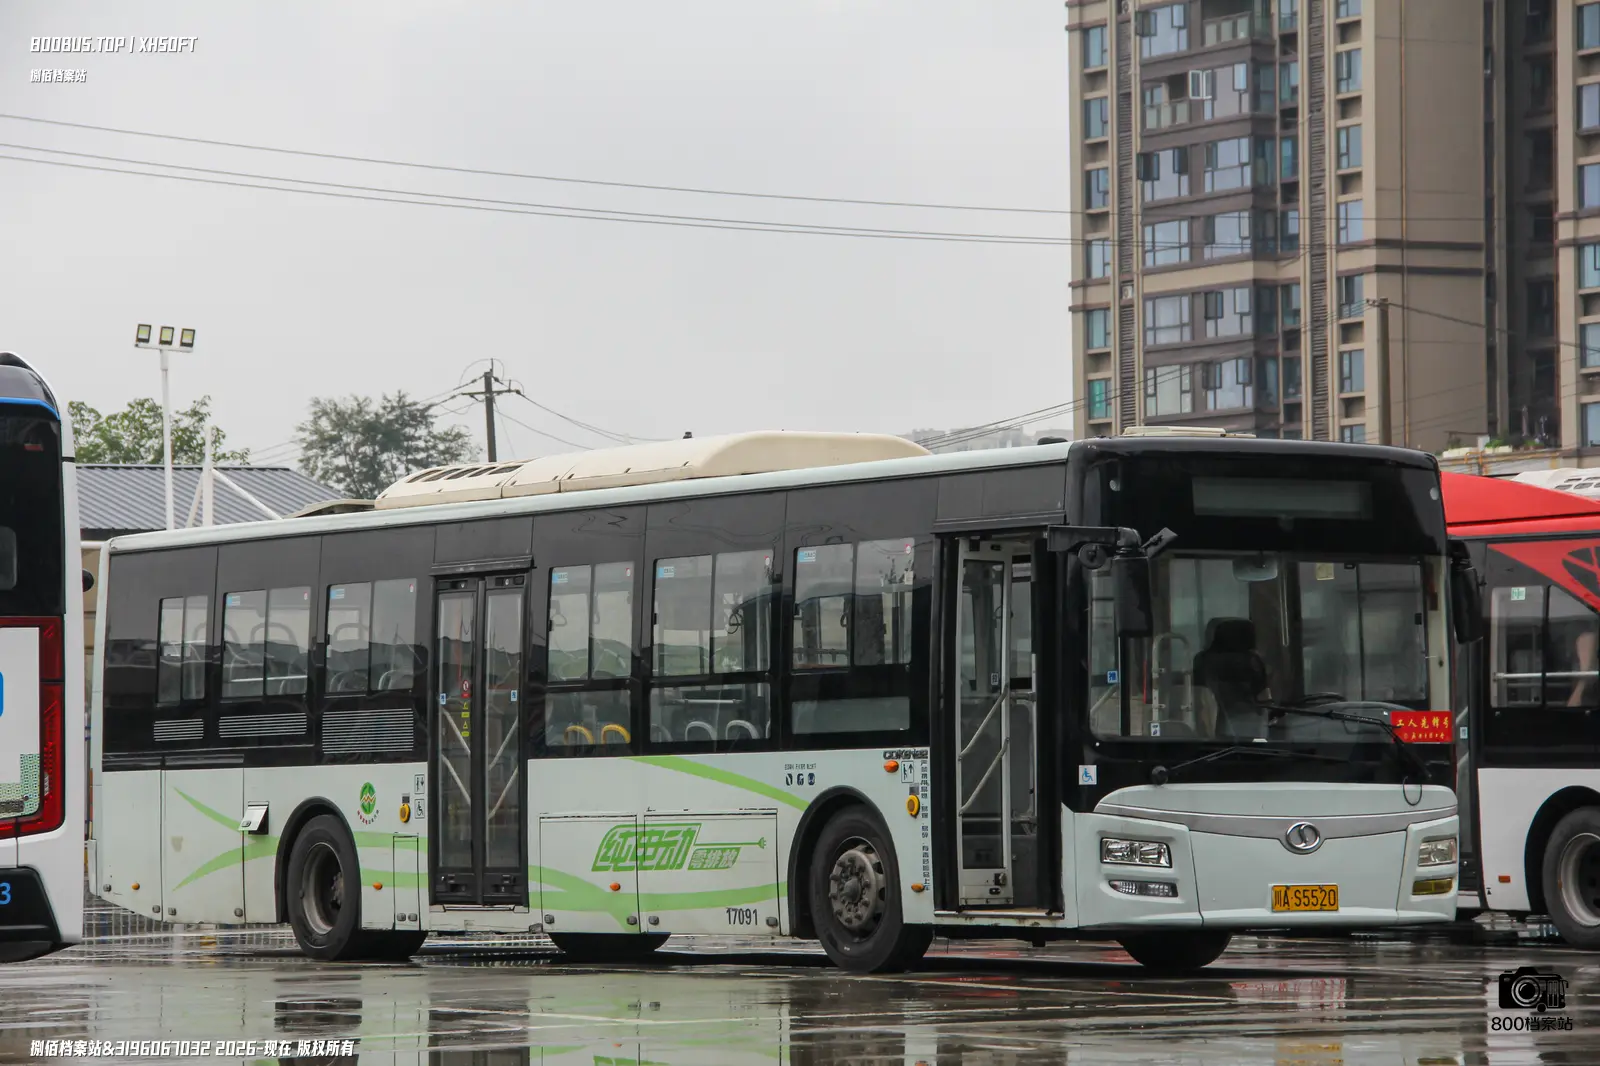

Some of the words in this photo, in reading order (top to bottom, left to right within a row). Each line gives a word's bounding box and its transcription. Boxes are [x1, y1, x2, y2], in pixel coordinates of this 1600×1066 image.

[1396, 716, 1449, 728] 工人先锋号
[593, 826, 697, 871] 纯电动
[690, 848, 738, 869] 零排放
[726, 908, 758, 925] 17091
